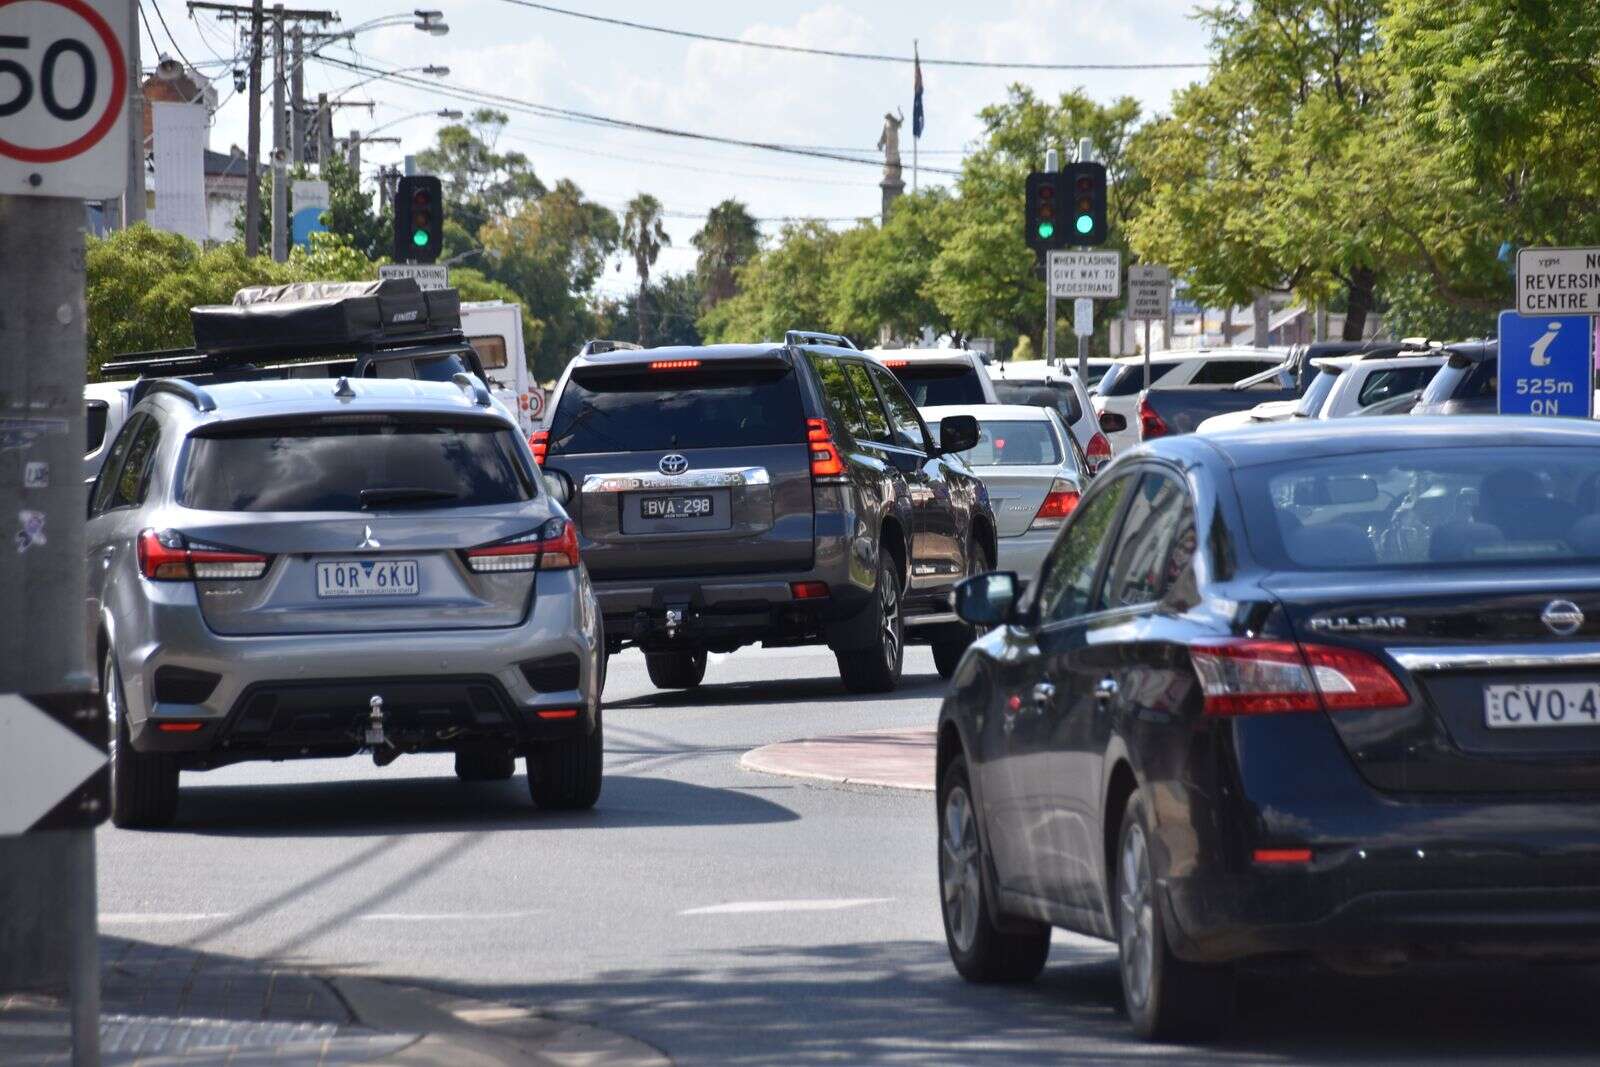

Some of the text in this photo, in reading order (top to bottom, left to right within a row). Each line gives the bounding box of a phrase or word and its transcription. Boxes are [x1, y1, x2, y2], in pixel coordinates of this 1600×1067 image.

[0, 35, 97, 121] 50
[1054, 255, 1117, 266] WHEN FLASHING
[1586, 253, 1600, 269] N
[381, 269, 445, 280] WHEN FLASHING
[1054, 269, 1116, 279] GIVE WAY TO
[1056, 283, 1113, 293] PEDESTRIANS
[1526, 293, 1588, 309] CENTRE
[393, 311, 418, 322] KINGS
[1516, 378, 1573, 395] 525m
[1530, 399, 1559, 416] ON
[323, 565, 415, 588] 1QR 6KU
[1310, 616, 1408, 630] PULSAR
